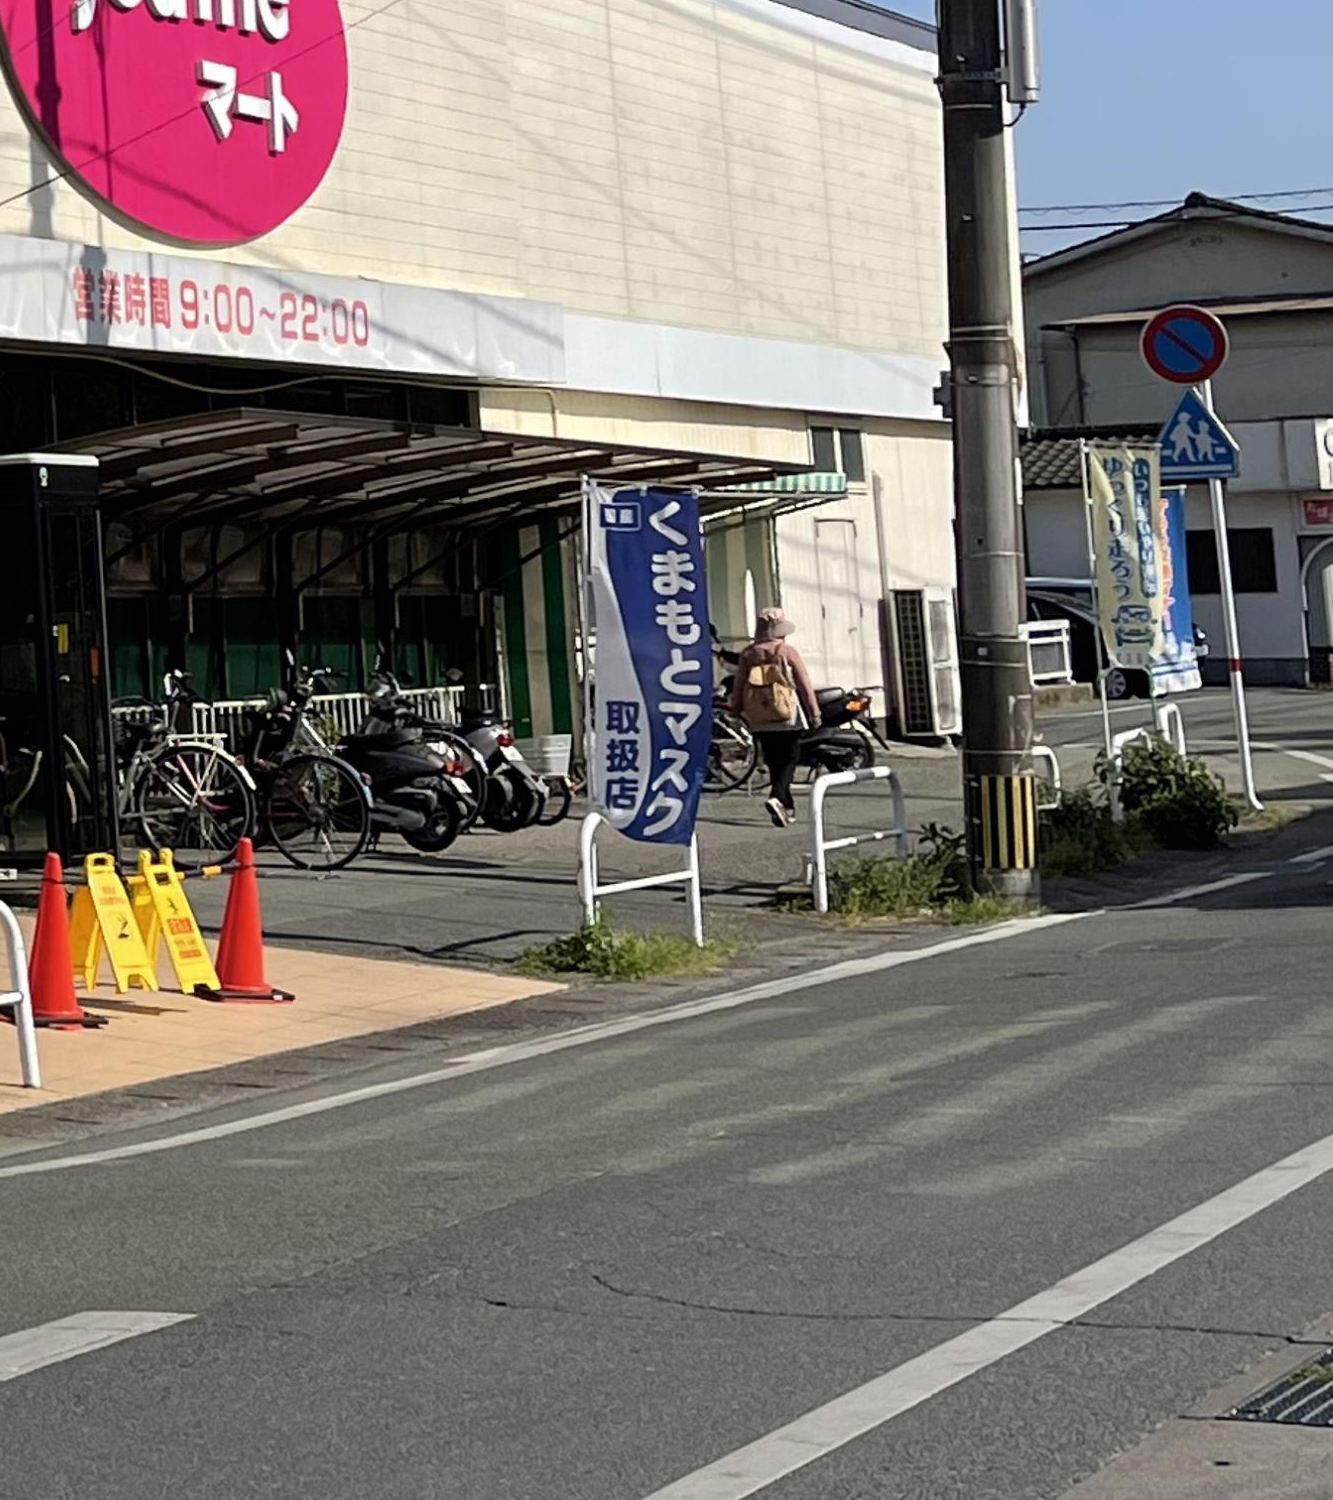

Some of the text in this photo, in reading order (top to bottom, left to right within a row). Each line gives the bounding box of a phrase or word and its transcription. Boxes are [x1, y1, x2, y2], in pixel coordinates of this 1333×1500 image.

[195, 58, 300, 155] マート
[72, 266, 171, 330] 営業時間
[642, 499, 702, 837] くまもとマスク
[605, 699, 641, 812] 取扱店
